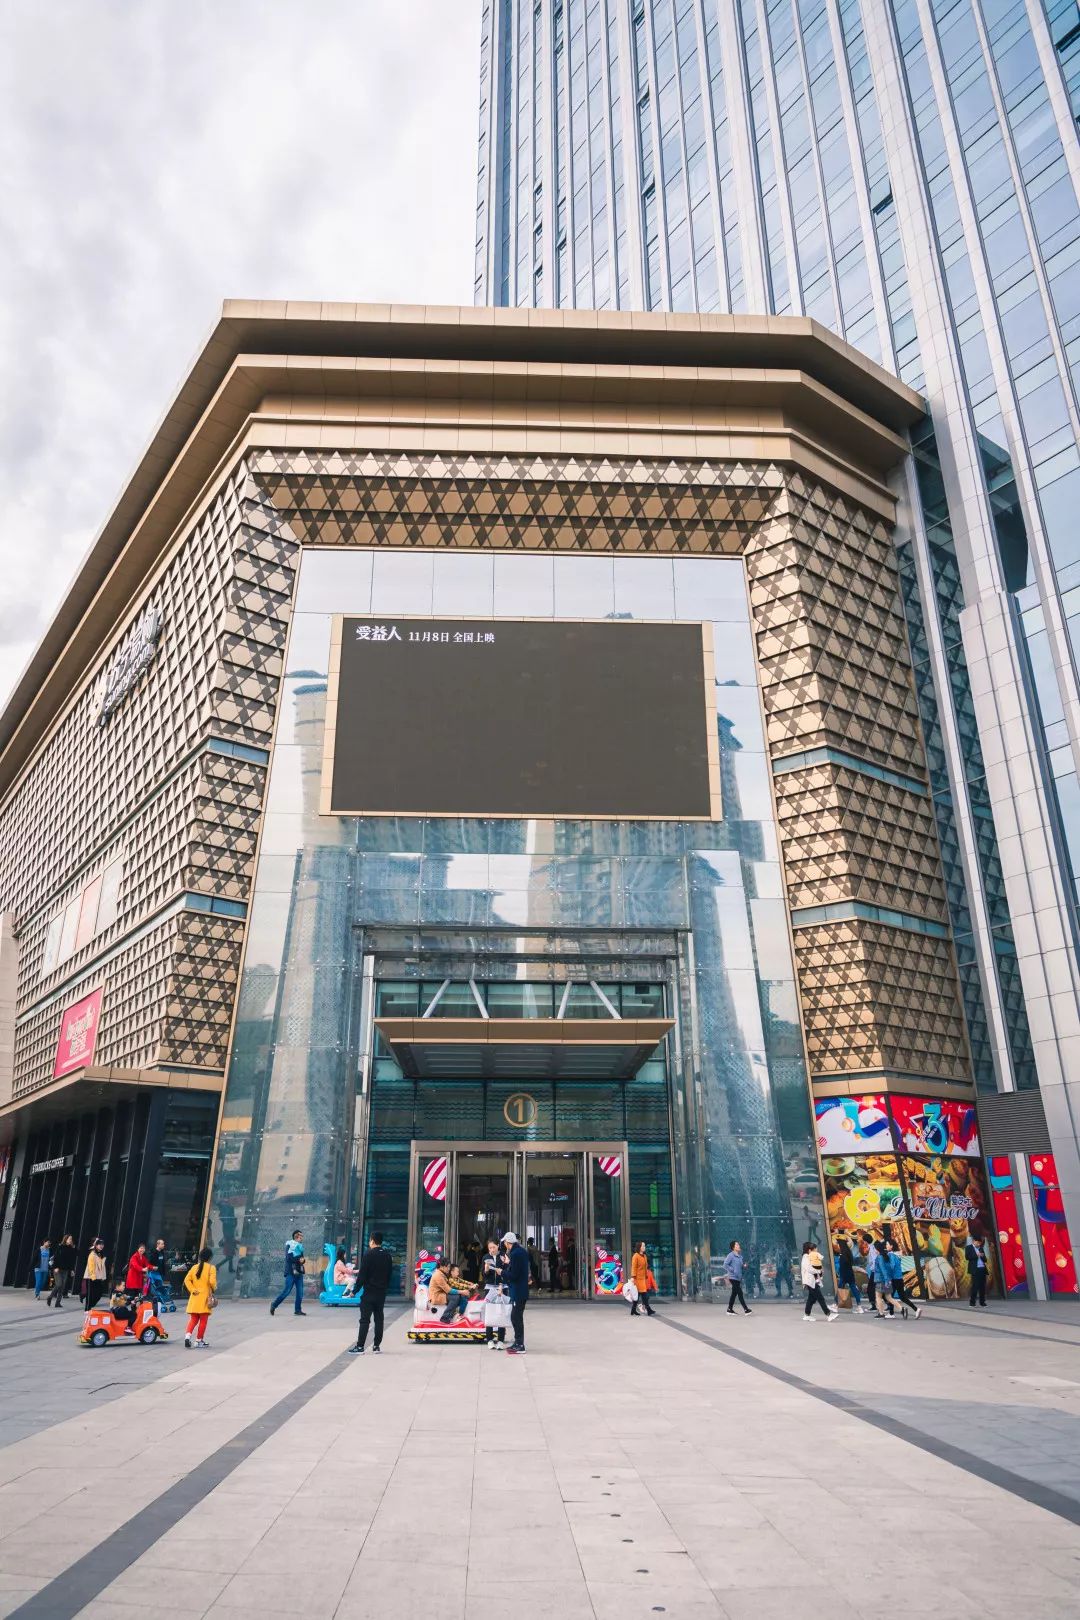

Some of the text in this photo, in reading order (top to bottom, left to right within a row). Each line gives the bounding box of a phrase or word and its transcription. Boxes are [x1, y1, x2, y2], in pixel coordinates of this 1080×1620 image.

[356, 625, 495, 643] 受益人 11月8日 全国上映
[513, 1099, 524, 1122] 1
[925, 1197, 980, 1219] Cheese
